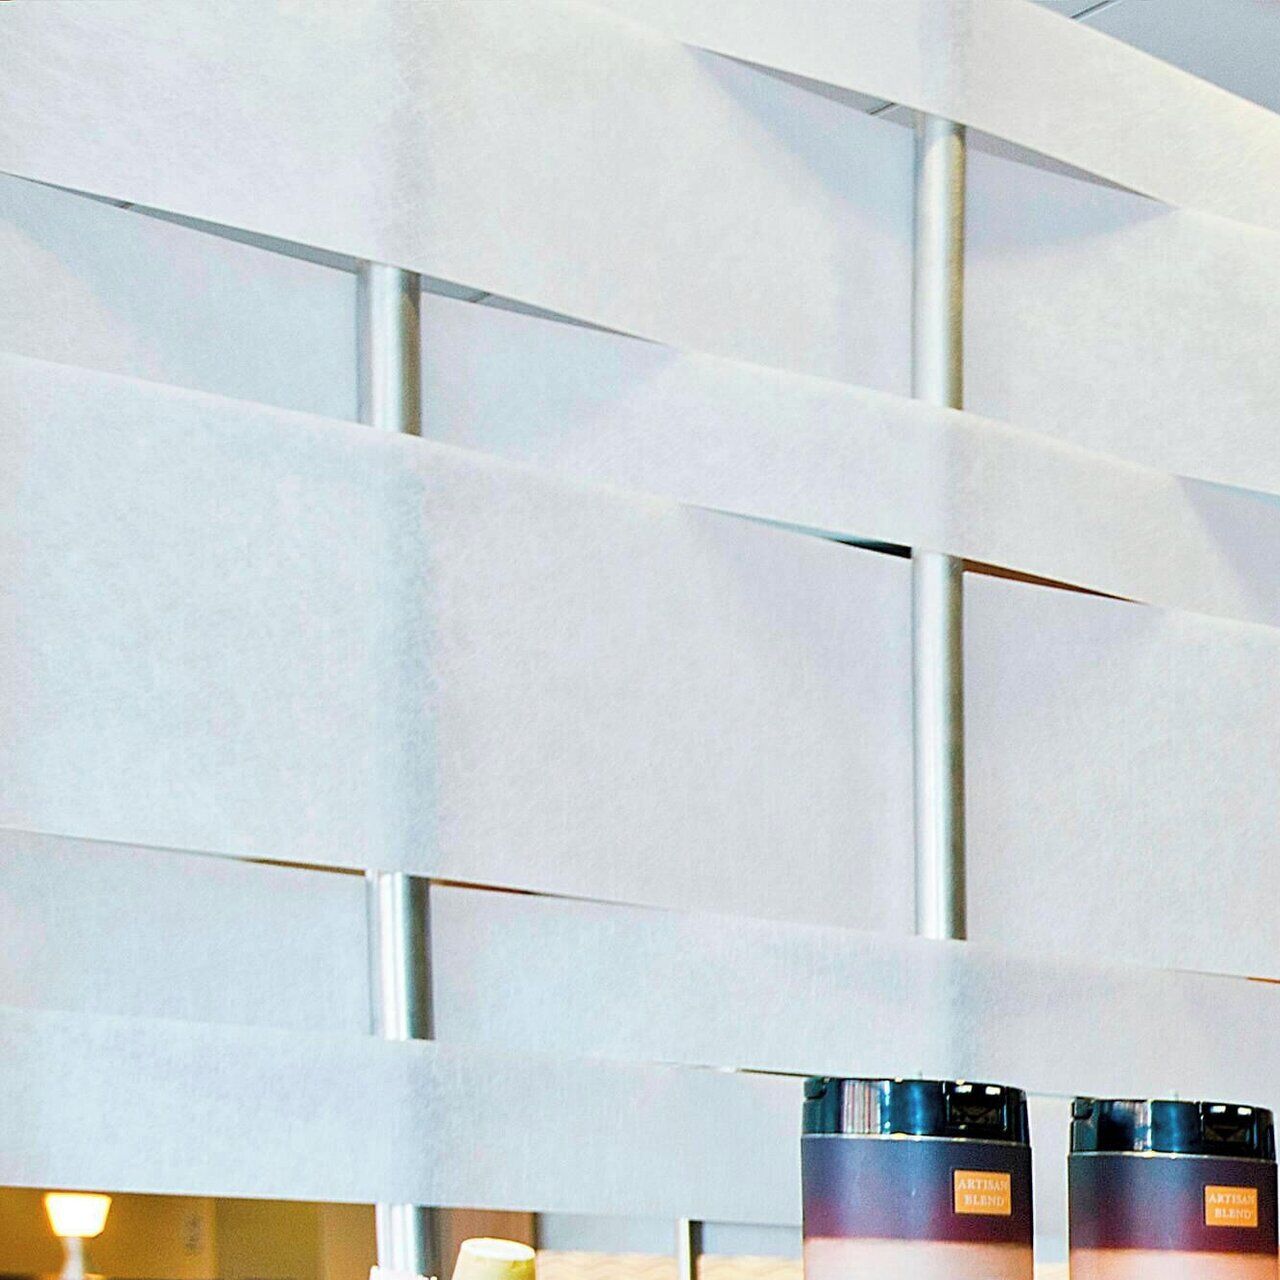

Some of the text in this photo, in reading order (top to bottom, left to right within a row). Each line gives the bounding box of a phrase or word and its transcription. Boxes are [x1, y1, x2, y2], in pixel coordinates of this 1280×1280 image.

[957, 1179, 1009, 1191] ARTISAN
[963, 1194, 1005, 1207] BLEND
[1208, 1193, 1255, 1204] ARTISAN
[1214, 1207, 1252, 1219] BLEND
